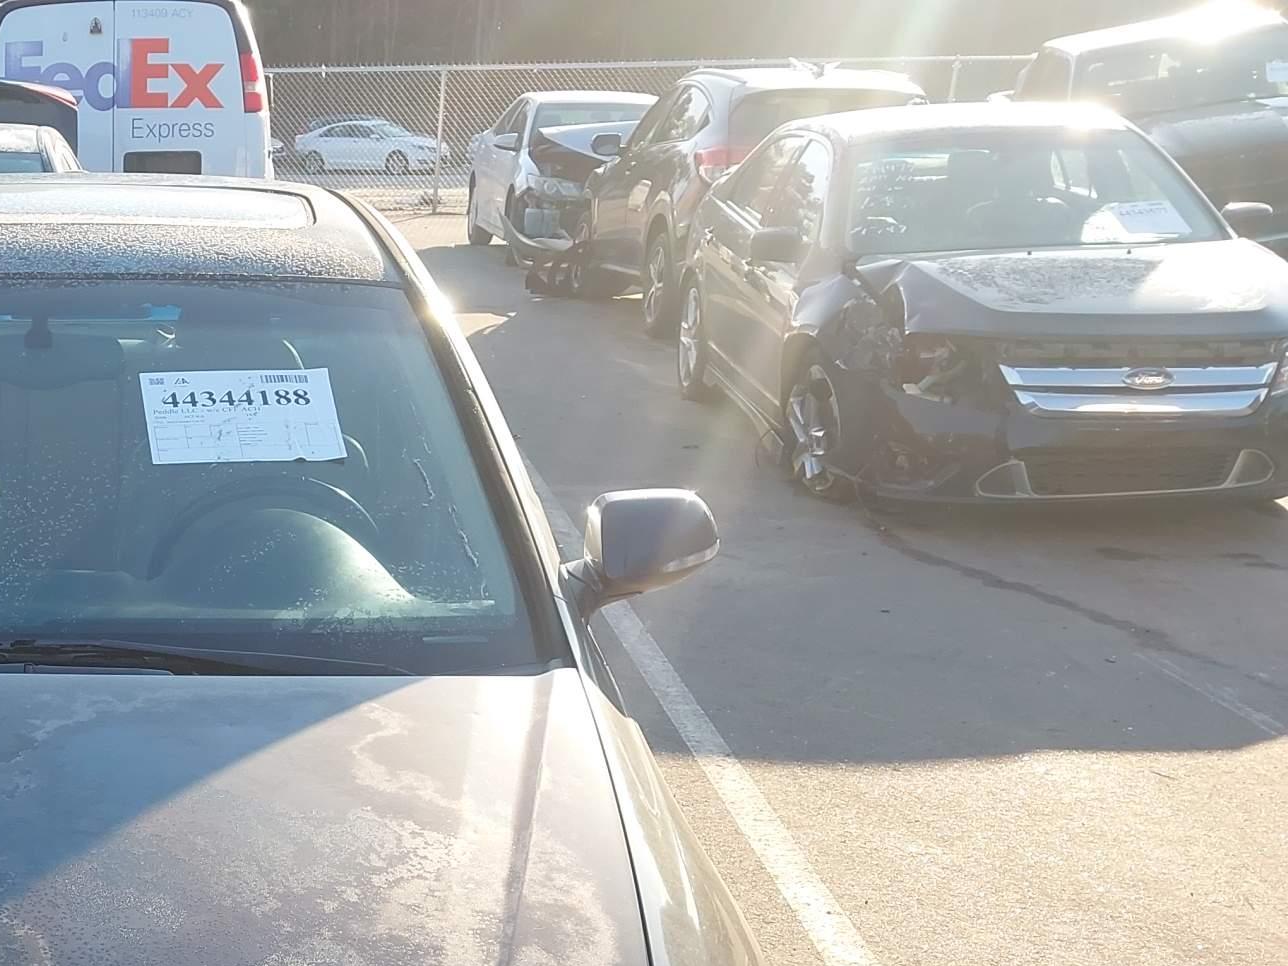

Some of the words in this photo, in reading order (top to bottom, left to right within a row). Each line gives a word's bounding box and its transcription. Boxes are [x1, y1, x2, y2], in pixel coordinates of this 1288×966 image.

[4, 38, 225, 112] FedEx
[131, 117, 215, 144] Express
[161, 388, 311, 408] 44344188
